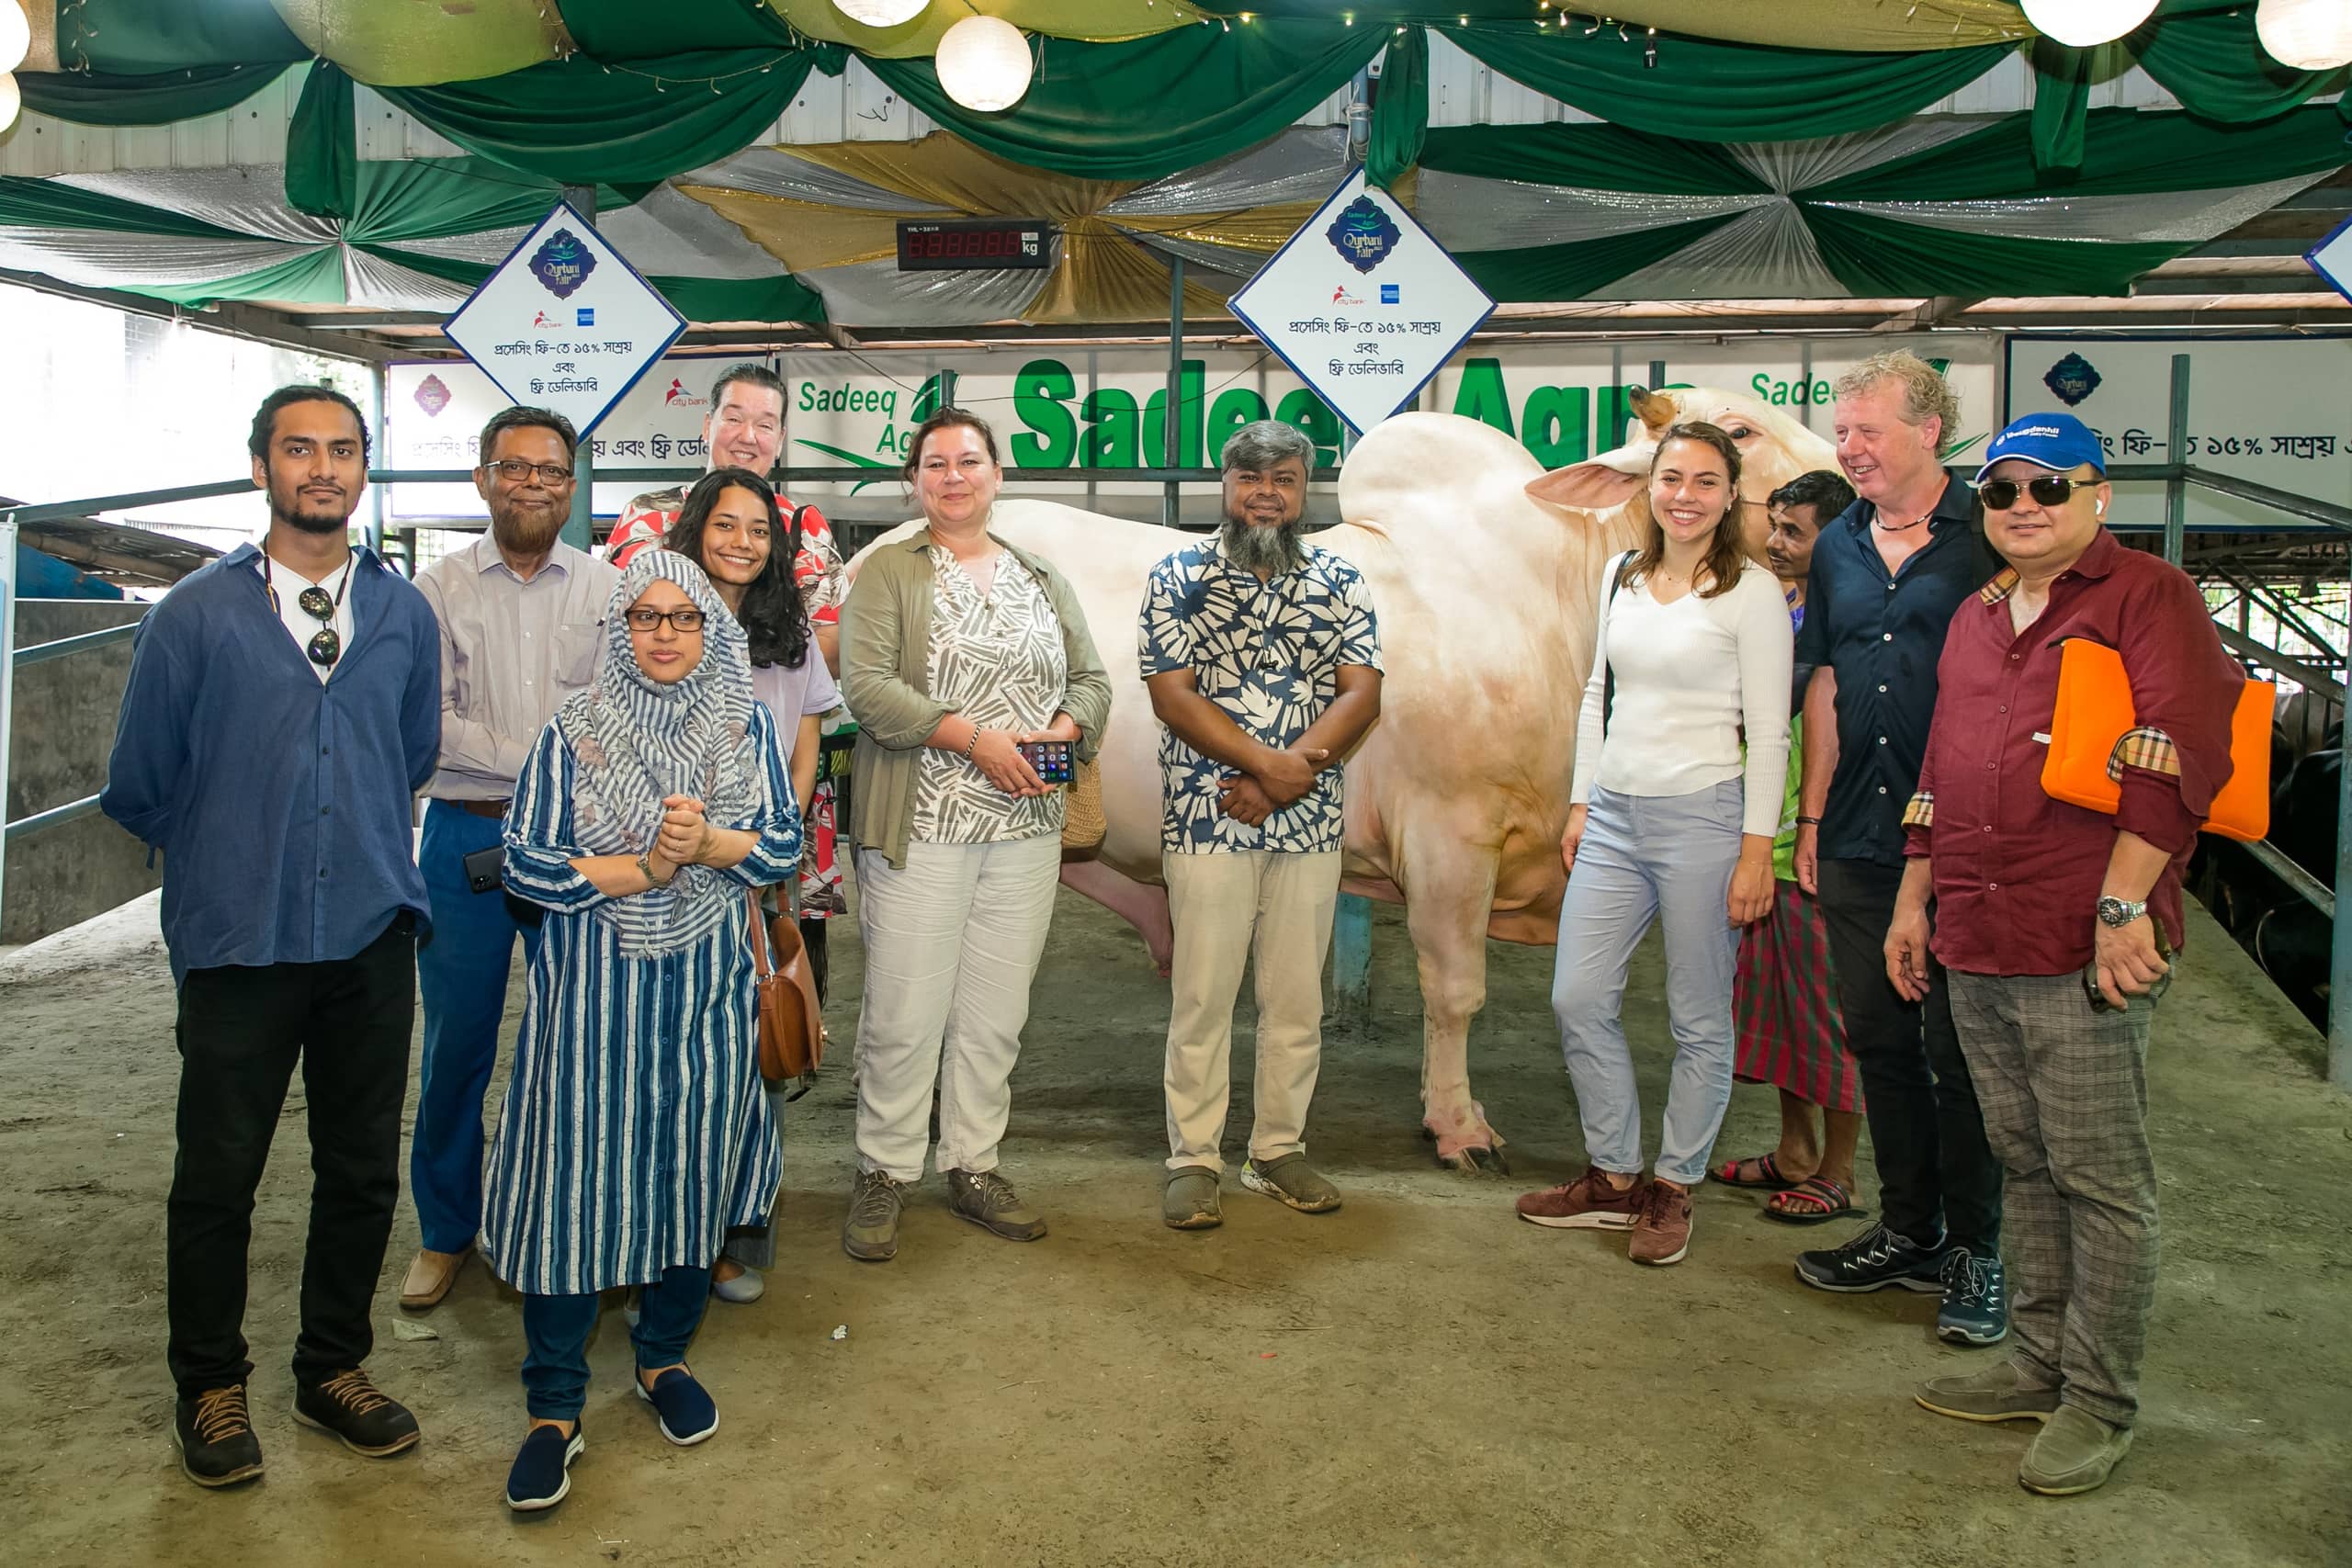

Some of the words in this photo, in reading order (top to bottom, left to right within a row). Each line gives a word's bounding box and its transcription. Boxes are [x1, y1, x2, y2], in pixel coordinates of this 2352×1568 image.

[1023, 242, 1038, 255] kg
[1343, 232, 1383, 249] Qurbani
[1356, 246, 1374, 258] Fair
[1289, 317, 1330, 334] প্রসেসিং
[1334, 317, 1373, 333] ফি-তে
[1377, 321, 1407, 333] ১৫%
[1409, 321, 1441, 335] সাশ্রয়
[494, 340, 532, 355] প্রসেসিং
[535, 340, 571, 355] ফি-তে
[574, 343, 600, 354] ১৫%
[603, 341, 632, 355] সাশ্রয়
[1353, 343, 1380, 355] এবং
[552, 362, 576, 373] এবং
[1329, 358, 1345, 376] ফ্রি
[1348, 359, 1404, 375] ডেলিভারি
[530, 378, 544, 394] ফ্রি
[548, 378, 598, 392] ডেলিভারি
[1752, 372, 1837, 405] Sade
[672, 398, 686, 406] city
[688, 397, 707, 405] bank
[798, 381, 897, 420] Sadeeq
[1011, 359, 1344, 468] Sadee
[1453, 357, 1698, 468] Agr
[612, 440, 646, 458] এবং
[650, 434, 673, 459] ফ্রি
[2207, 436, 2263, 456] ১৫%
[2270, 436, 2336, 459] সাশ্রয়
